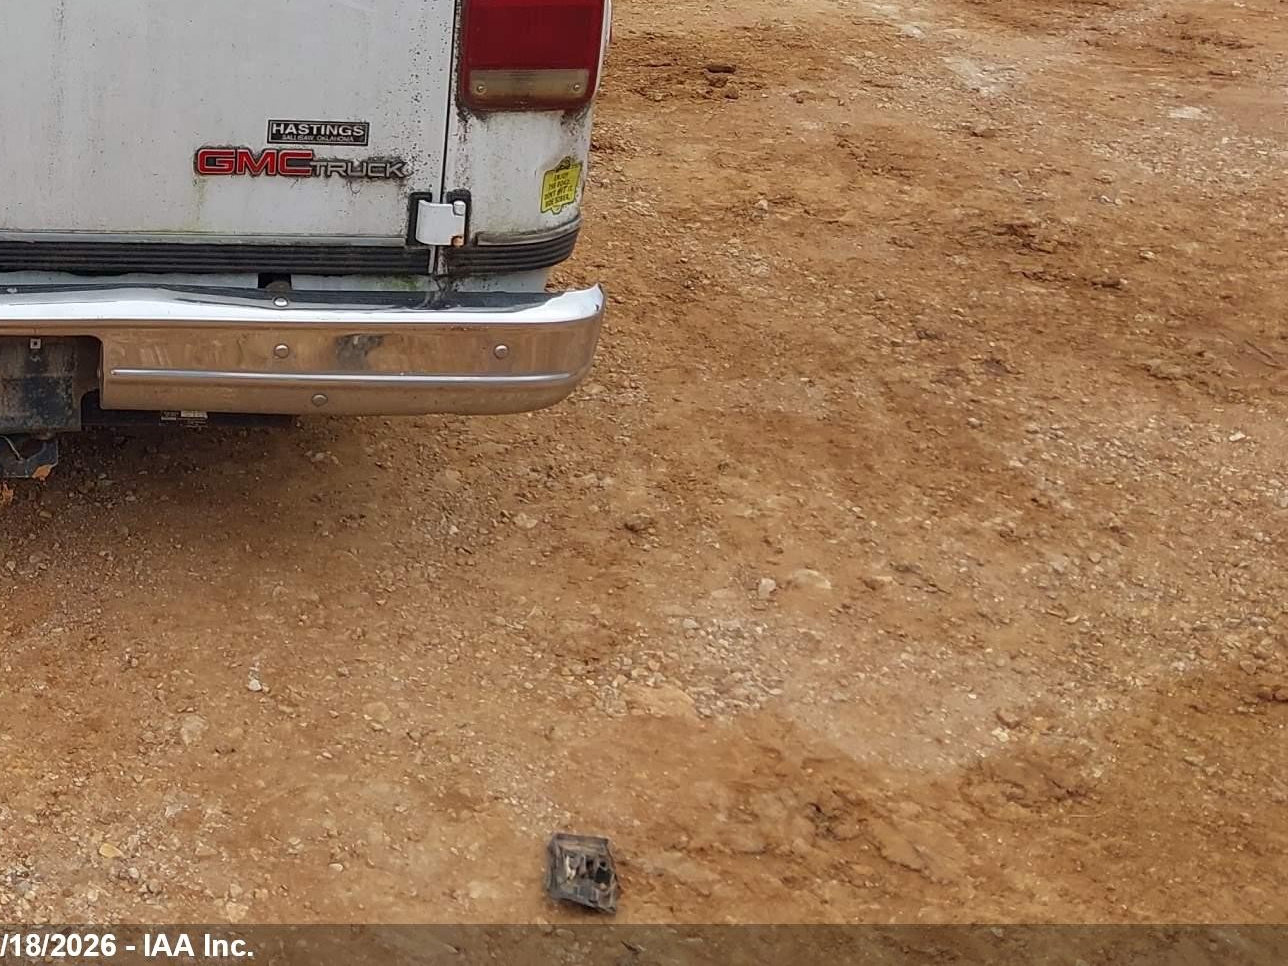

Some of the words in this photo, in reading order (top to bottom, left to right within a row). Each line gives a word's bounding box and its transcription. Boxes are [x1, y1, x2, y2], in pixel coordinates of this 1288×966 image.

[272, 123, 365, 136] HASTINGS
[198, 149, 313, 176] GMC
[311, 161, 406, 178] TRUCK
